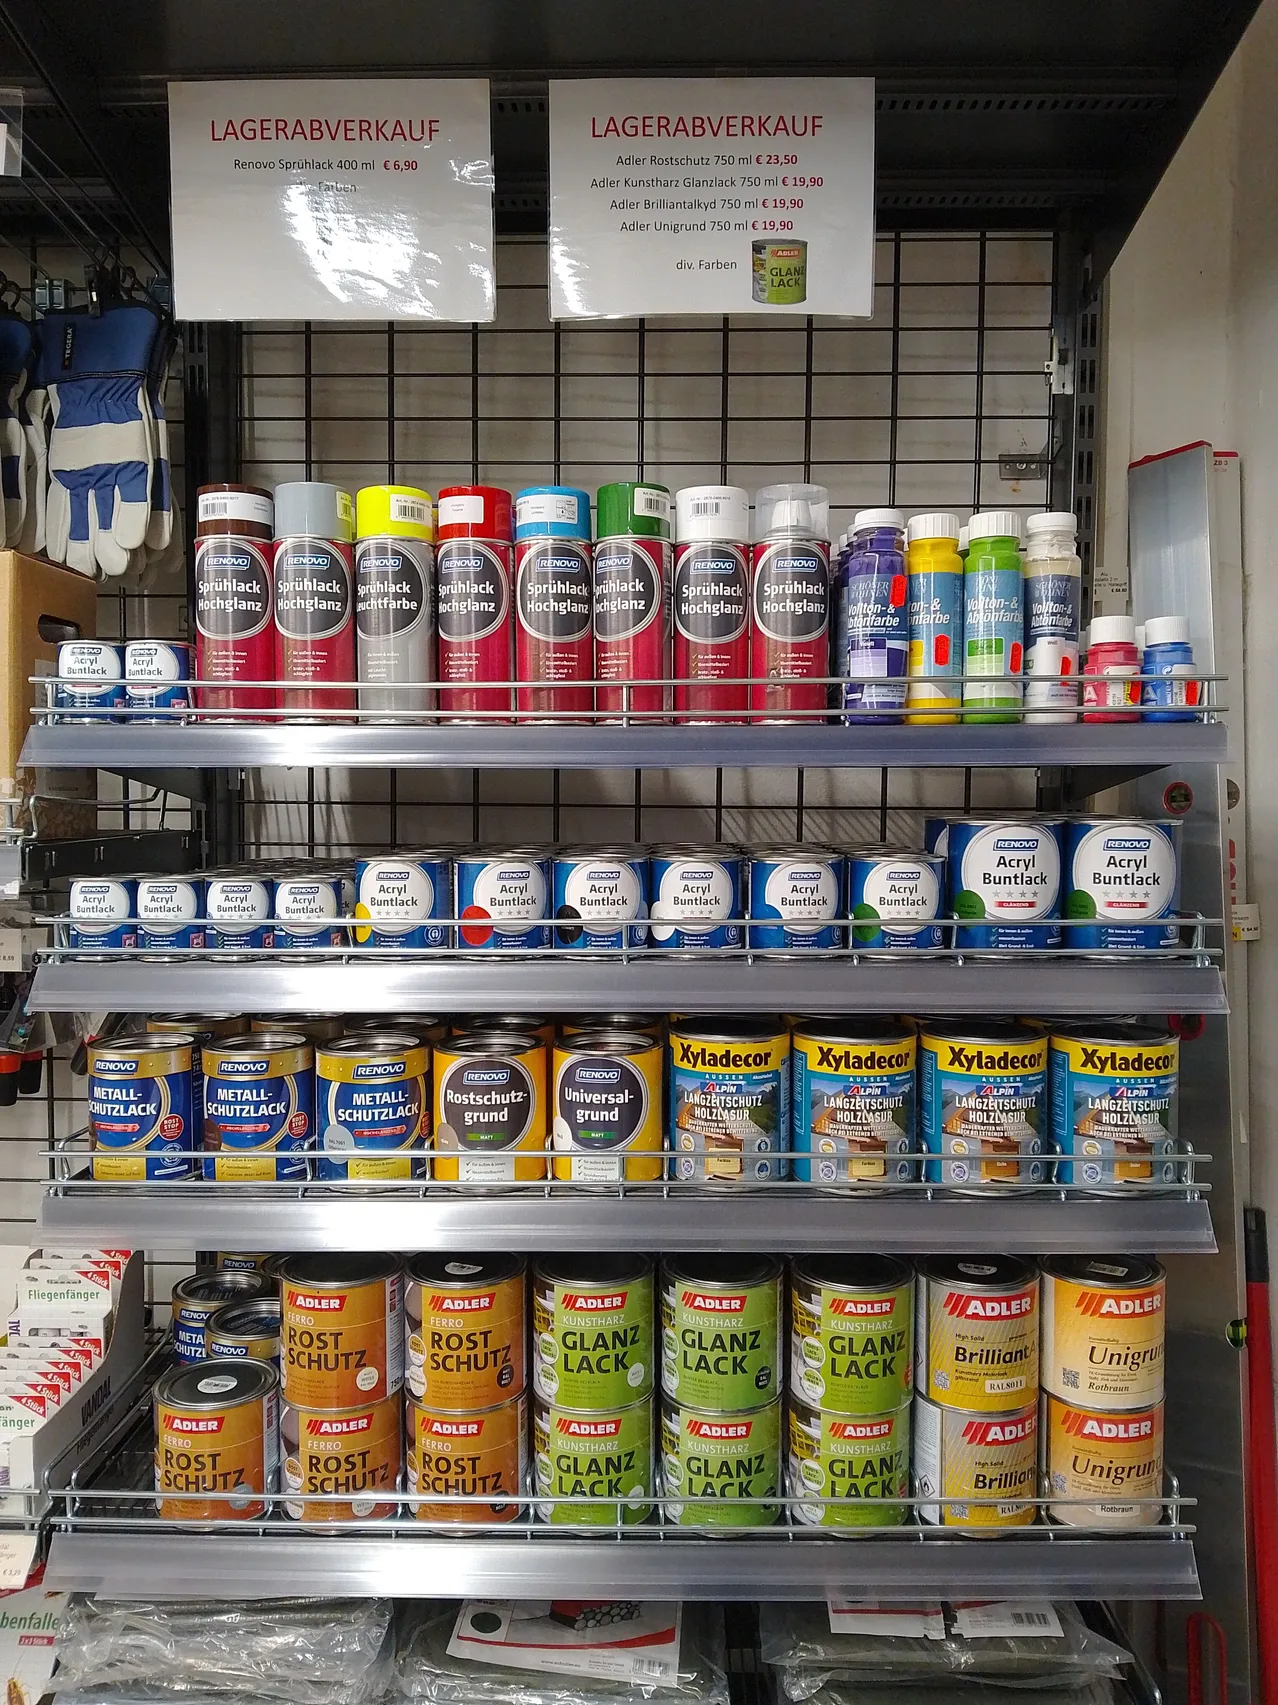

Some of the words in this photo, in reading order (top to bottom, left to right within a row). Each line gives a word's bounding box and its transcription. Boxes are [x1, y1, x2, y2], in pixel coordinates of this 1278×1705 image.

[211, 119, 440, 142] LAGERABVERKAUF
[591, 115, 824, 138] LAGERABVERKAUF
[234, 160, 275, 170] Renovo
[279, 159, 333, 171] Sprühlack
[337, 160, 357, 170] 400
[362, 159, 375, 170] ml
[383, 160, 390, 170] €
[393, 160, 418, 172] 6,90
[616, 156, 646, 166] Adler
[650, 156, 710, 166] Rostschutz
[714, 155, 734, 165] 750
[738, 155, 752, 165] ml
[756, 155, 763, 165] €
[766, 155, 798, 166] 23,50
[591, 178, 620, 188] Adler
[624, 177, 679, 188] Kunstharz
[683, 177, 736, 188] Glanzlack
[740, 177, 761, 187] 750
[765, 177, 777, 187] ml
[782, 177, 789, 187] €
[792, 177, 823, 188] 19,90
[610, 200, 640, 210] Adler
[644, 199, 716, 212] Brilliantalkyd
[721, 200, 741, 209] 750
[745, 198, 758, 209] ml
[762, 199, 769, 209] €
[772, 199, 803, 210] 19,90
[620, 221, 650, 232] Adler
[654, 221, 706, 233] Unigrund
[710, 221, 730, 231] 750
[735, 220, 748, 231] ml
[752, 221, 758, 231] €
[762, 221, 793, 232] 19,90
[676, 260, 694, 270] div.
[699, 259, 737, 269] Farben
[770, 266, 805, 278] GLANZ
[771, 277, 800, 288] LACK
[64, 327, 72, 358] TEGERA
[208, 556, 248, 566] RENOVO
[288, 556, 327, 566] RENOVO
[777, 560, 816, 568] RENOVO
[199, 578, 261, 596] Sprühlack
[278, 578, 341, 595] Sprühlack
[527, 581, 589, 597] Sprühlack
[682, 583, 743, 599] Sprühlack
[764, 581, 824, 598] Sprühlack
[199, 597, 262, 613] Hochglanz
[278, 596, 341, 612] Hochglanz
[527, 599, 589, 615] Hochglanz
[682, 601, 743, 617] Hochglanz
[763, 599, 825, 615] Hochglanz
[967, 597, 1009, 611] Vollton-
[1011, 597, 1018, 608] &
[74, 657, 98, 666] Acryl
[133, 658, 153, 667] Acryl
[67, 667, 107, 675] Buntlack
[128, 668, 163, 676] Buntlack
[997, 840, 1038, 849] RENOVO
[1107, 840, 1149, 849] RENOVO
[996, 855, 1035, 871] Acryl
[1107, 855, 1147, 871] Acryl
[982, 872, 1047, 885] Buntlack
[1093, 872, 1160, 886] Buntlack
[378, 884, 407, 896] Acryl
[500, 883, 528, 896] Acryl
[589, 883, 618, 896] Acryl
[682, 883, 711, 896] Acryl
[790, 883, 819, 896] Acryl
[889, 883, 918, 896] Acryl
[82, 895, 106, 904] Acryl
[370, 896, 418, 907] Buntlack
[490, 895, 537, 907] Buntlack
[579, 896, 628, 906] Buntlack
[673, 896, 721, 906] Buntlack
[781, 896, 828, 906] Buntlack
[879, 896, 927, 907] Buntlack
[76, 905, 115, 914] Buntlack
[680, 1043, 772, 1068] Xyladecor
[817, 1046, 910, 1072] Xyladecor
[948, 1046, 1042, 1072] Xyladecor
[1080, 1048, 1175, 1073] Xyladecor
[96, 1062, 136, 1072] RENOVO
[220, 1062, 266, 1072] RENOVO
[357, 1064, 404, 1076] RENOVO
[468, 1072, 507, 1081] RENOVO
[579, 1071, 618, 1079] RENOVO
[94, 1086, 142, 1100] METALL-
[217, 1087, 273, 1101] METALL-
[353, 1090, 409, 1106] METALL-
[447, 1089, 528, 1105] Rostschutz-
[565, 1086, 634, 1104] Universal-
[684, 1091, 762, 1107] LANGZEITSCHUTZ
[824, 1096, 903, 1110] LANGZEITSCHUTZ
[955, 1096, 1036, 1110] LANGZEITSCHUTZ
[1089, 1098, 1169, 1112] LANGZEITSCHUTZ
[207, 1102, 286, 1118] SCHUTZLACK
[338, 1102, 419, 1122] SCHUTZLACK
[465, 1108, 508, 1125] grund
[576, 1107, 619, 1123] grund
[695, 1106, 749, 1121] HOLZLASUR
[836, 1111, 893, 1123] HOLZLASUR
[969, 1111, 1026, 1124] HOLZLASUR
[1102, 1112, 1159, 1125] HOLZLASUR
[223, 1260, 255, 1269] RENOVO
[28, 1289, 100, 1301] Fliegenfänger
[296, 1296, 341, 1309] ADLER
[442, 1298, 489, 1310] ADLER
[575, 1297, 622, 1309] ADLER
[966, 1296, 1031, 1316] ADLER
[1100, 1294, 1161, 1315] ADLER
[288, 1311, 314, 1326] FERRO
[430, 1317, 464, 1328] FERRO
[563, 1315, 625, 1327] KUNSTHARZ
[682, 1314, 743, 1327] KUNSTHARZ
[288, 1326, 343, 1351] ROST
[430, 1330, 492, 1351] ROST
[561, 1325, 640, 1352] GLANZ
[681, 1329, 760, 1352] GLANZ
[955, 1333, 969, 1342] High
[970, 1334, 985, 1342] Solid
[211, 1343, 246, 1355] RENOVO
[955, 1343, 1030, 1365] Brilliant
[288, 1349, 367, 1371] SCHUTZ
[430, 1344, 511, 1372] SCHUTZ
[564, 1351, 629, 1374] LACK
[683, 1351, 748, 1375] LACK
[1088, 1382, 1129, 1392] Rotbraun
[26, 1400, 44, 1414] Stück
[172, 1418, 218, 1431] ADLER
[164, 1434, 192, 1448] FERRO
[830, 1441, 891, 1454] KUNSTHARZ
[164, 1449, 221, 1472] ROST
[1101, 1505, 1134, 1513] Rotbraun
